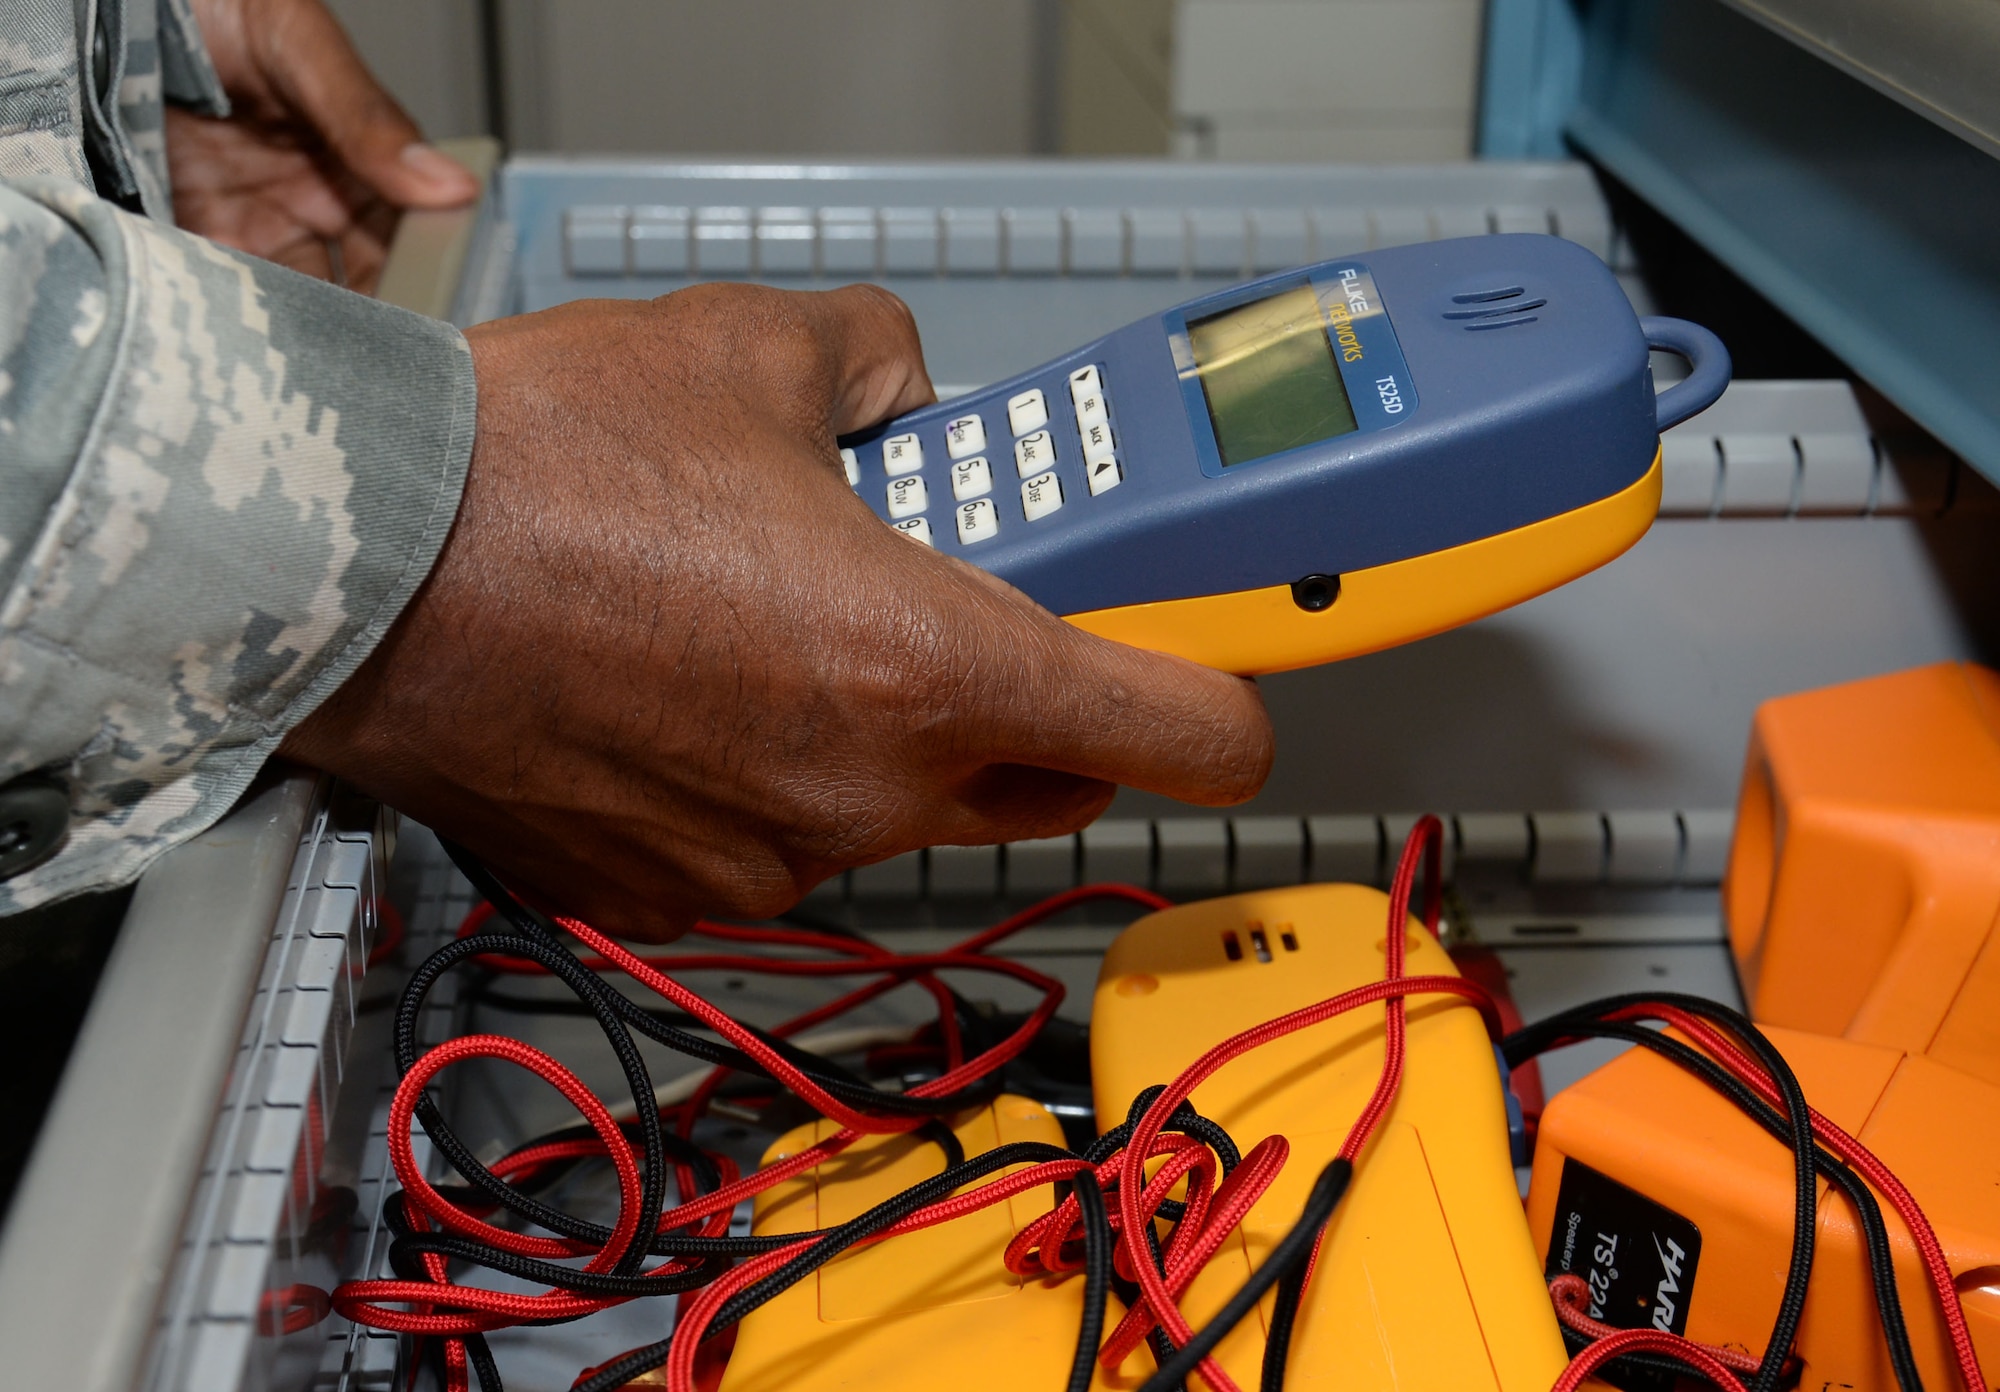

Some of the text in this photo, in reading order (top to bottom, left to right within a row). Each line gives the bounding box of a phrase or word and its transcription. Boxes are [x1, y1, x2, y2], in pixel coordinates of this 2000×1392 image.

[1338, 268, 1369, 313] FLUKE
[1328, 303, 1364, 363] networks
[1014, 397, 1037, 409] 1
[1084, 398, 1096, 412] SEL
[1375, 375, 1404, 414] TS25D
[1089, 426, 1102, 446] BACK
[1560, 1211, 1582, 1270] Speakerp
